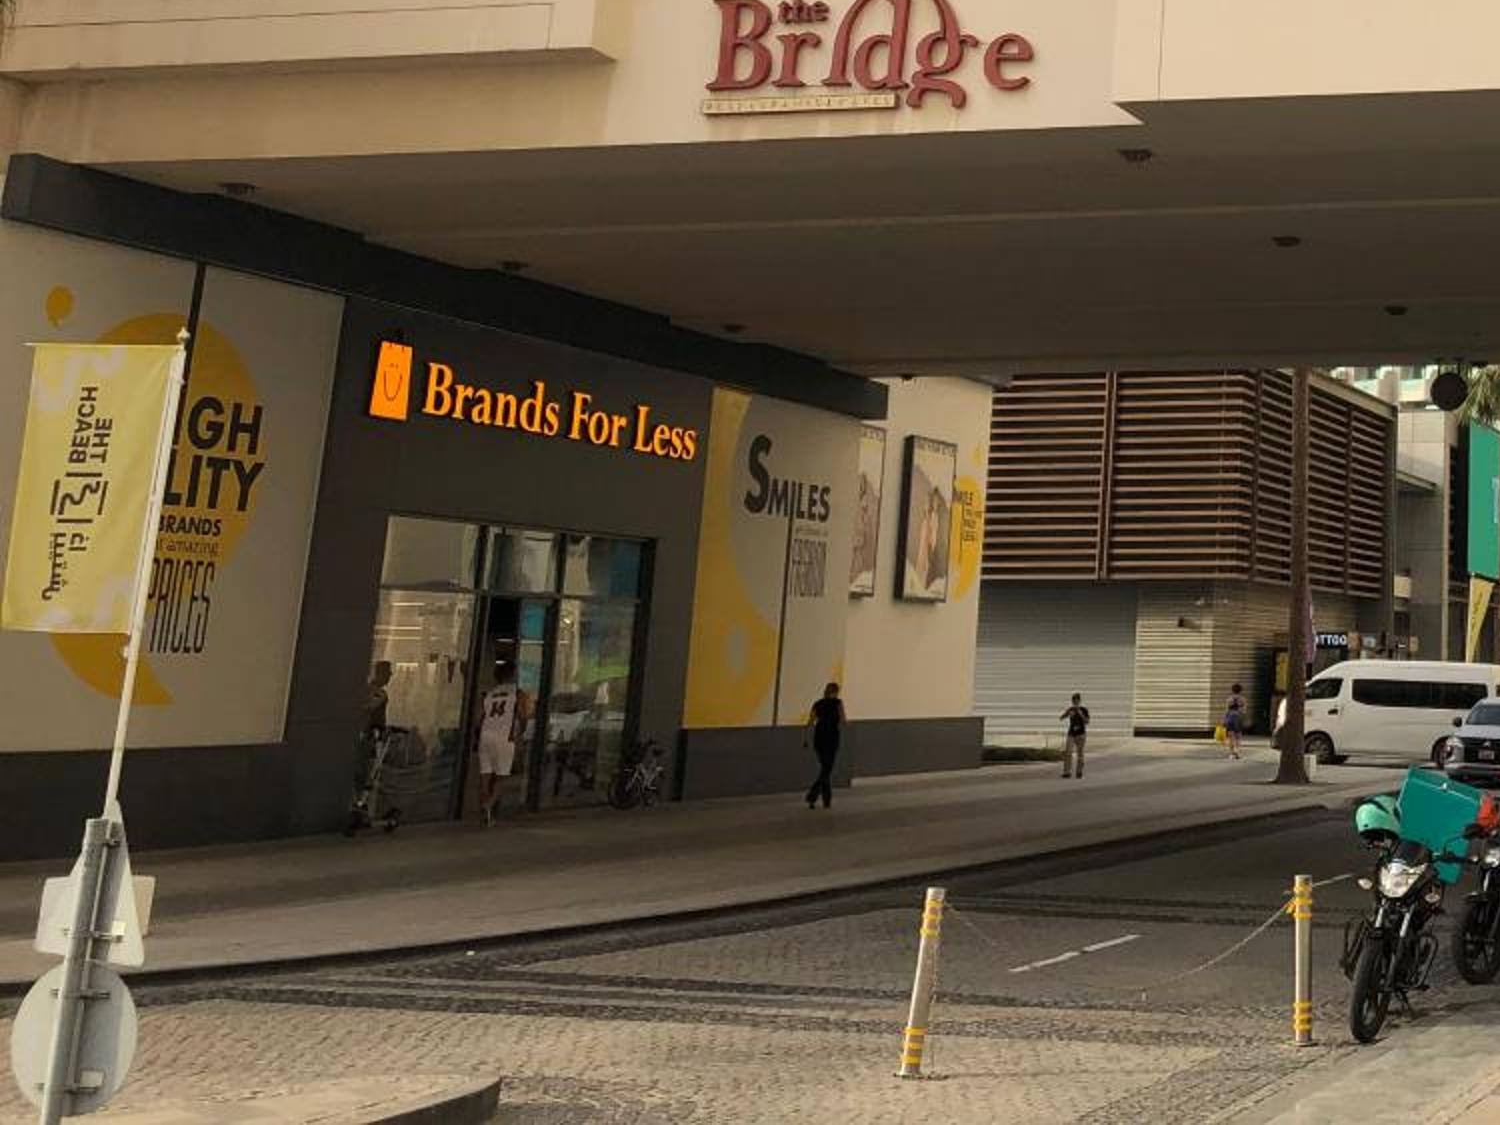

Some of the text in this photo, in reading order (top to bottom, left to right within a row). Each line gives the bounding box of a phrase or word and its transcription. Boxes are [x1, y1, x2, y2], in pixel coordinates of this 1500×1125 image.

[172, 391, 263, 455] IGH
[422, 362, 697, 460] Brands For Less
[163, 448, 265, 512] LITY
